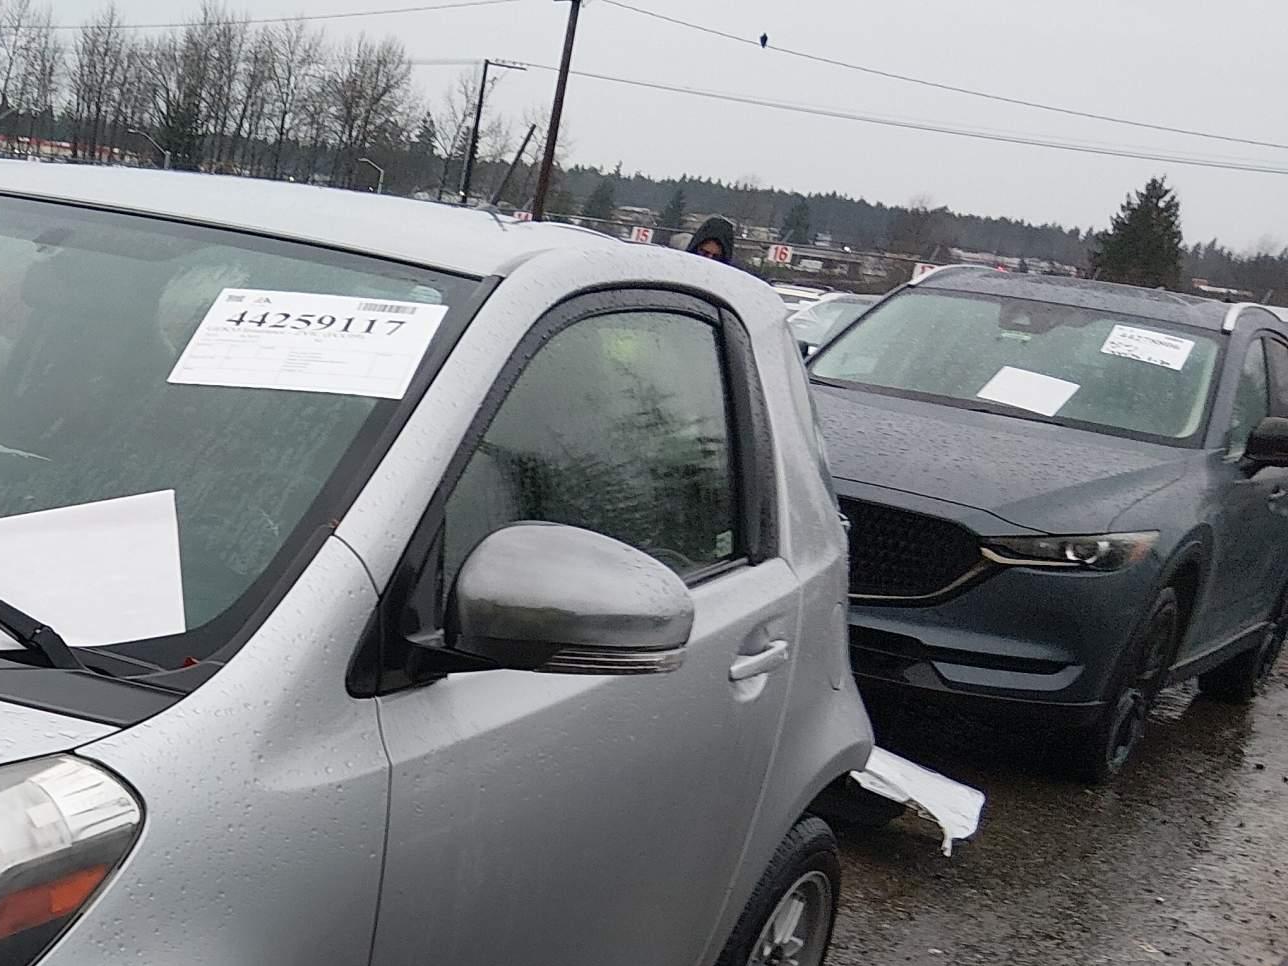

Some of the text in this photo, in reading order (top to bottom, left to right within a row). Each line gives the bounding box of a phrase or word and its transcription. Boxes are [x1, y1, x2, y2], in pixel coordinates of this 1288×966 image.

[635, 228, 650, 243] 15
[773, 246, 790, 261] 16
[225, 310, 407, 336] 44259117
